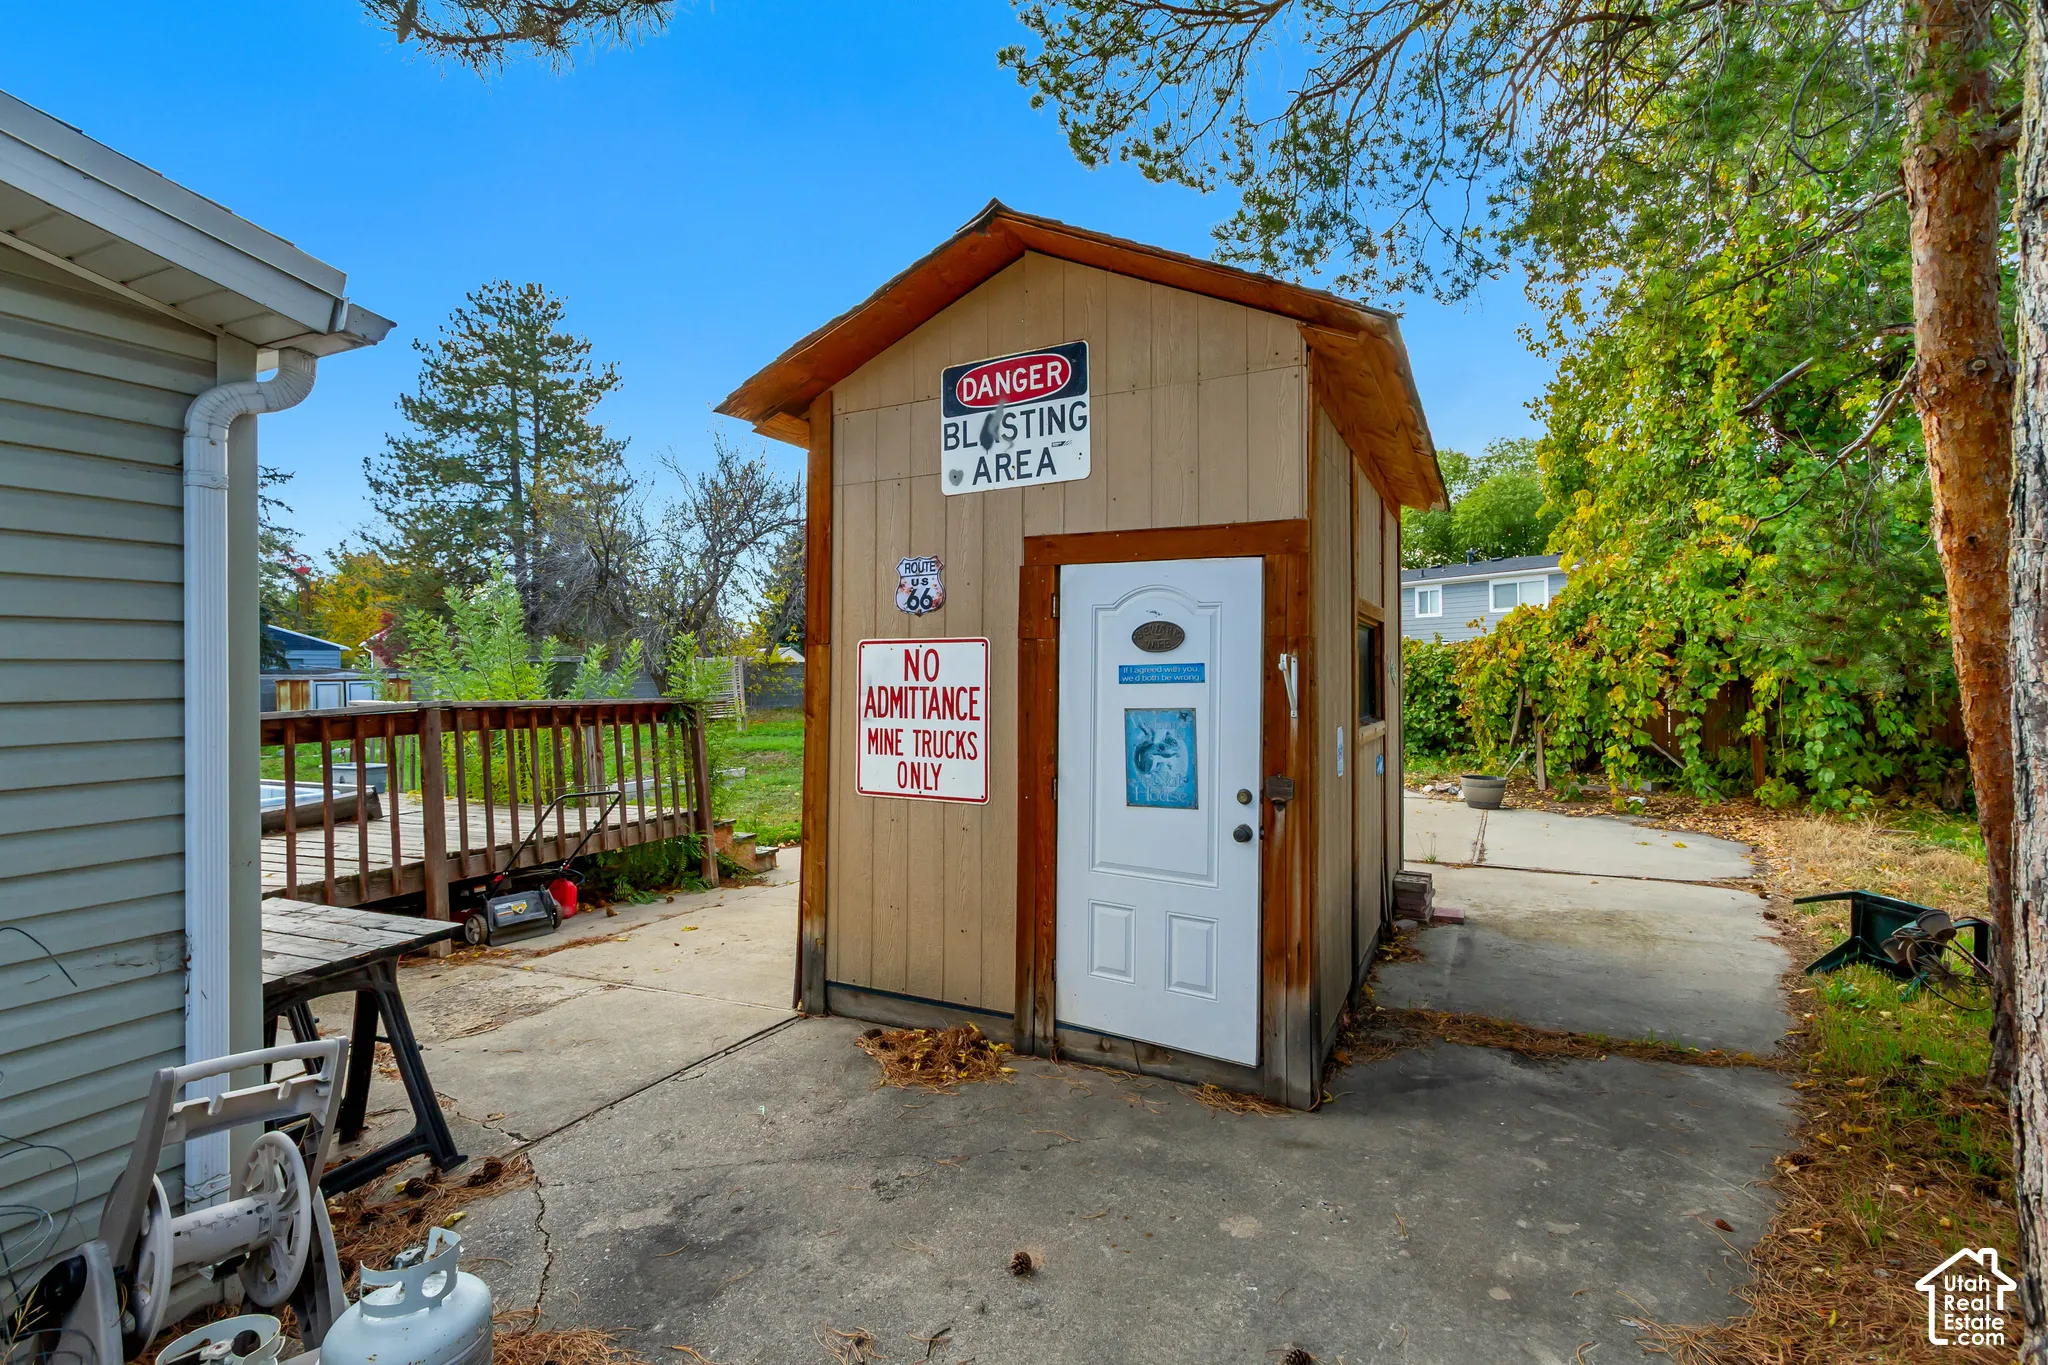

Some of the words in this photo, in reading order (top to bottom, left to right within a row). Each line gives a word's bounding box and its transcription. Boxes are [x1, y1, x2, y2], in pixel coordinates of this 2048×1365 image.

[962, 360, 1062, 402] DANGER
[972, 446, 1057, 486] AREA
[904, 560, 936, 574] ROUTE
[911, 577, 929, 587] US
[906, 587, 933, 610] 66
[904, 648, 940, 682] NO
[1134, 666, 1162, 675] agreed
[1141, 674, 1159, 682] both
[864, 685, 980, 721] ADMITTANCE
[867, 727, 904, 756] MINE
[912, 729, 978, 761] TRUCKS
[897, 761, 942, 791] ONLY
